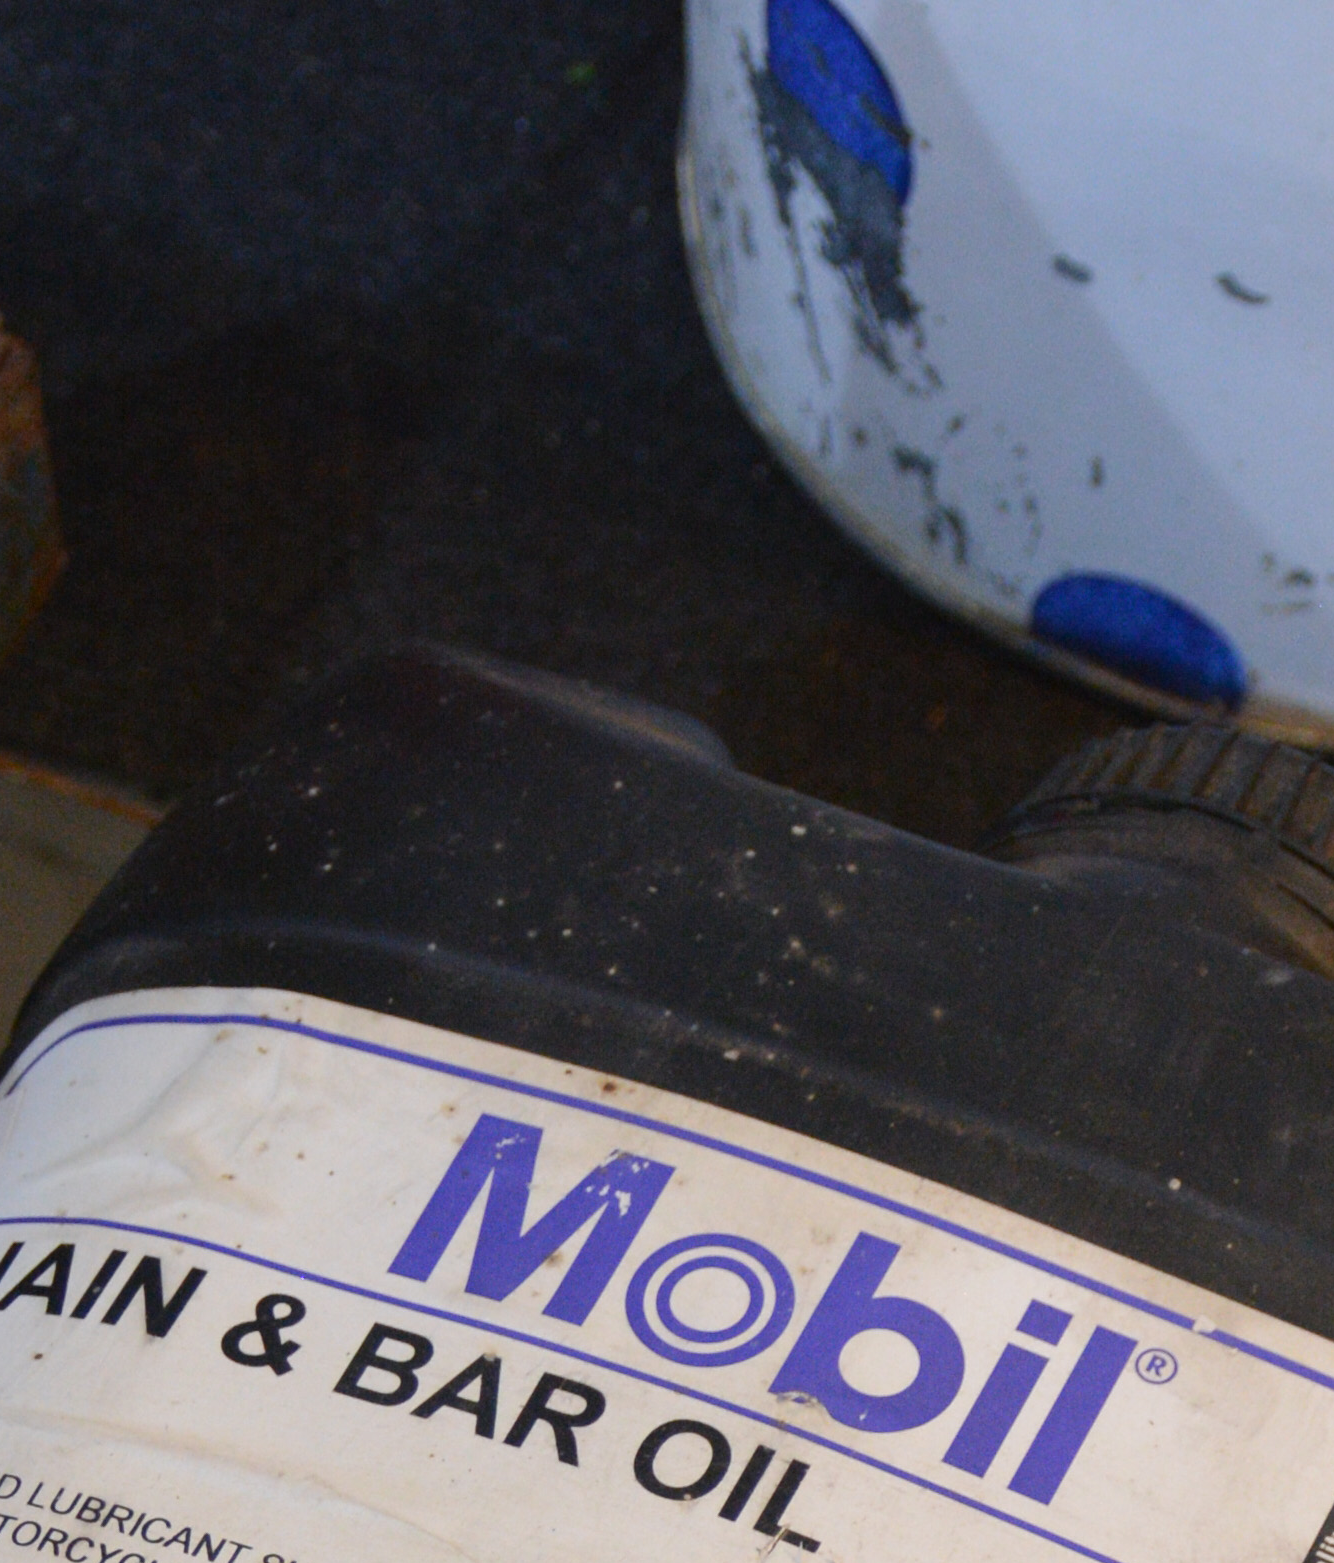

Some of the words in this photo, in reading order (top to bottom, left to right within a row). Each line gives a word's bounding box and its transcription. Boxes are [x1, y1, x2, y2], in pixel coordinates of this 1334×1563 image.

[220, 1292, 307, 1377] &
[332, 1321, 607, 1468] BAR
[632, 1417, 822, 1554] OIL
